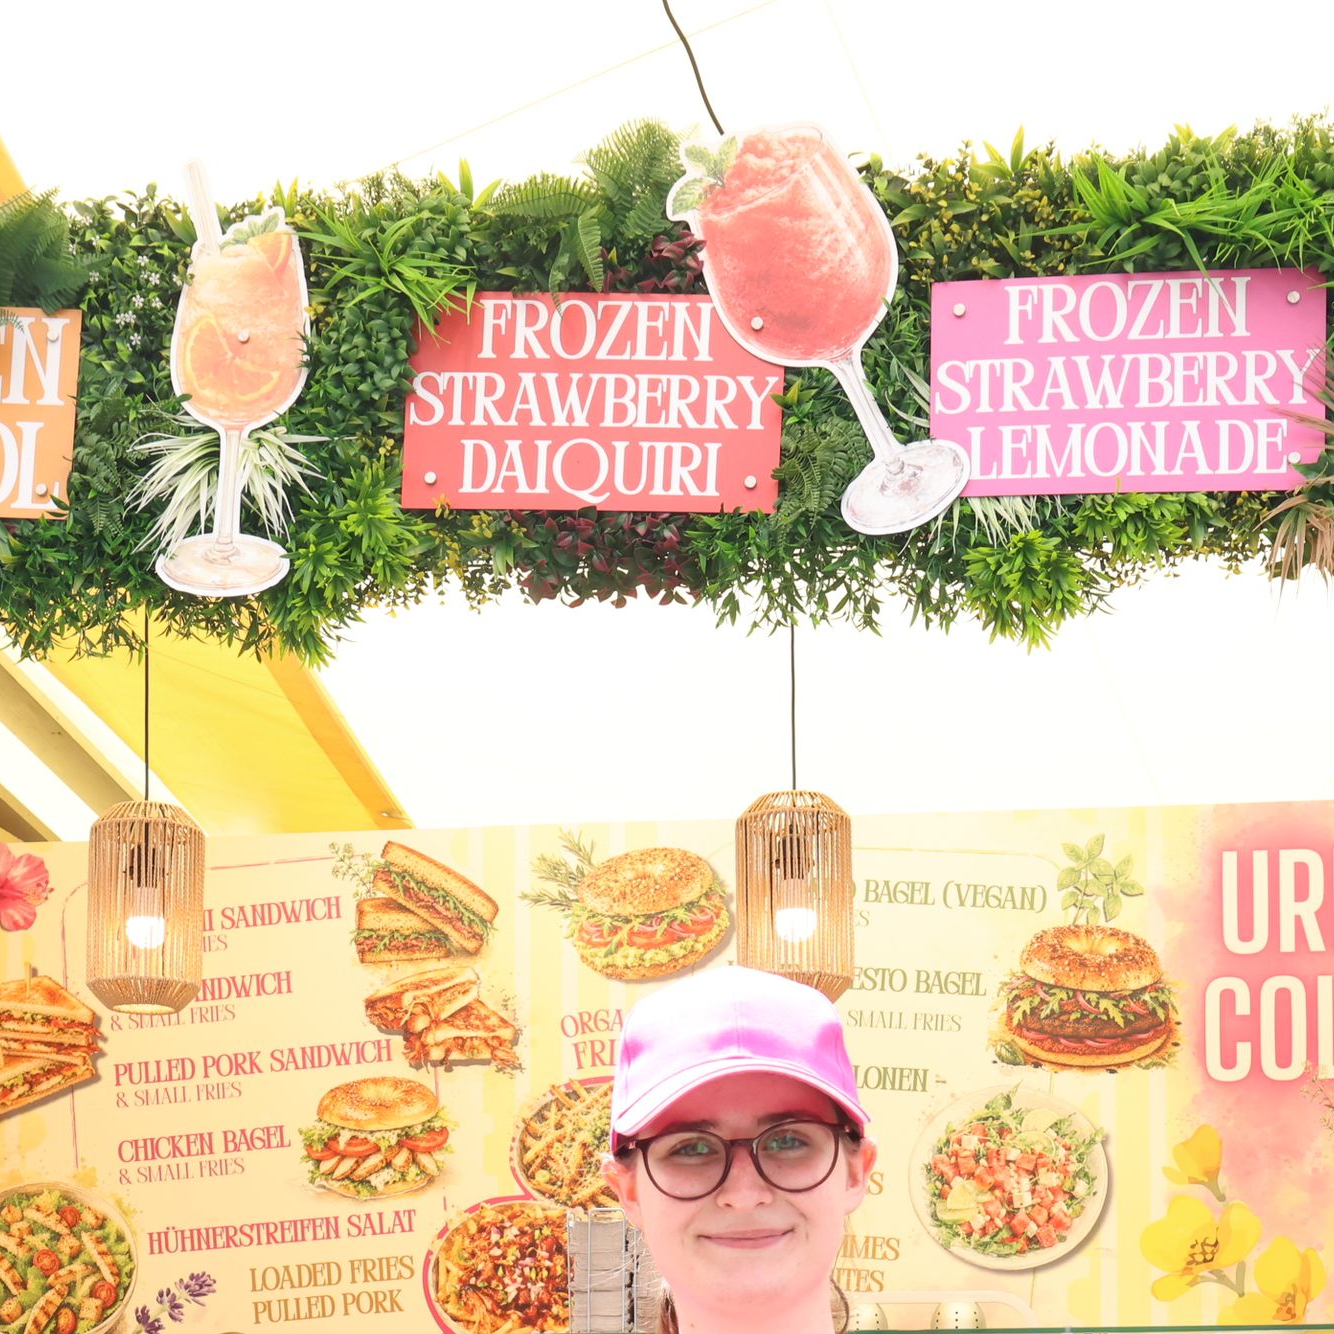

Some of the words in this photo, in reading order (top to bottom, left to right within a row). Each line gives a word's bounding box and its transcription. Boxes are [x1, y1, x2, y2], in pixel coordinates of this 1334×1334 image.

[1003, 276, 1251, 346] FROZEN
[480, 299, 712, 362] FROZEN
[408, 372, 780, 430] STRAWBERRY
[934, 349, 1318, 416] STRAWBERRY
[967, 418, 1289, 480] LEMONADE
[459, 439, 721, 505] DAIQUIRI
[221, 896, 342, 931] SANDWICH
[864, 879, 935, 906] BAGEL
[942, 880, 1047, 913] (VEGAN)
[195, 971, 293, 1003] NDWICH
[851, 968, 908, 993] ESTO
[915, 970, 988, 996] BAGEL
[110, 1014, 124, 1033] &
[128, 1012, 186, 1031] SMALL
[190, 1004, 236, 1024] FRIES
[847, 1010, 908, 1032] SMALL
[913, 1013, 962, 1033] FRIES
[114, 1060, 196, 1088] PULLED
[202, 1050, 262, 1080] PORK
[269, 1039, 393, 1074] SANDWICH
[116, 1091, 127, 1109] &
[132, 1086, 192, 1107] SMALL
[198, 1081, 242, 1102] FRIES
[117, 1132, 213, 1164] CHICKEN
[222, 1125, 291, 1155] BAGEL
[119, 1168, 131, 1186] &
[136, 1164, 193, 1183] SMALL
[199, 1158, 245, 1178] FRIES
[147, 1217, 341, 1256] HÜHNERSTREIFEN
[346, 1209, 416, 1237] SALAT
[249, 1264, 341, 1293] LOADED
[349, 1256, 414, 1282] FRIES
[253, 1296, 336, 1325] PULLED
[342, 1289, 404, 1317] PORK
